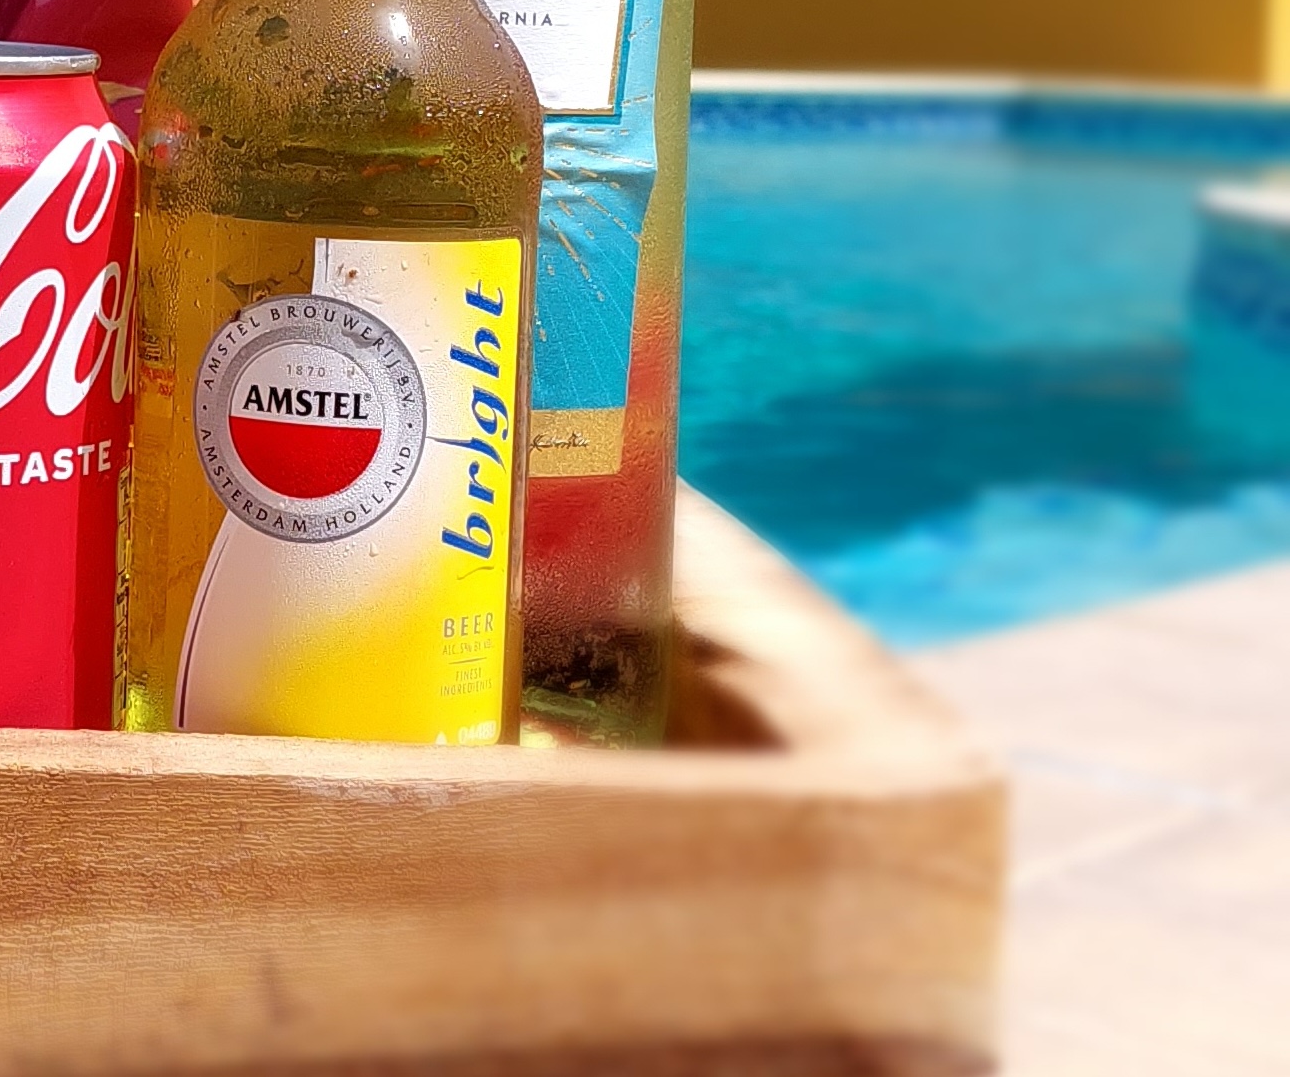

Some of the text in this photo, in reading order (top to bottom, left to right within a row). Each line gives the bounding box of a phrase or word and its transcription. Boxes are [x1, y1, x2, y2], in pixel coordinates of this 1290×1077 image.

[499, 11, 553, 26] RNIA
[203, 316, 260, 391] AMSTEL
[270, 305, 401, 369] BROUWERIJ
[286, 364, 326, 378] 1870
[242, 384, 369, 420] AMSTEL
[441, 279, 509, 560] bright
[201, 428, 411, 533] AMSTERDAM HOLLAND
[443, 612, 494, 638] BEER
